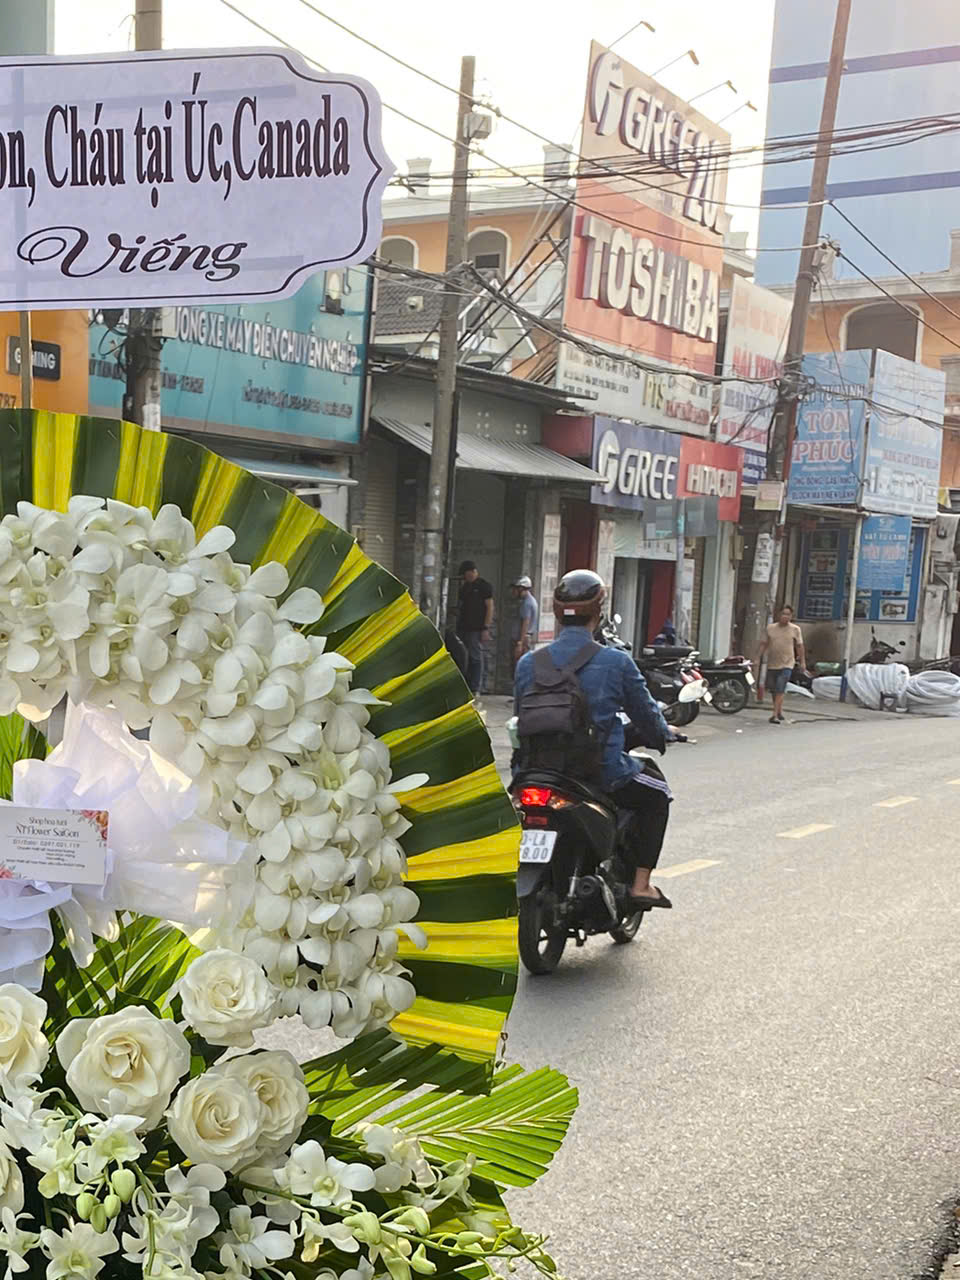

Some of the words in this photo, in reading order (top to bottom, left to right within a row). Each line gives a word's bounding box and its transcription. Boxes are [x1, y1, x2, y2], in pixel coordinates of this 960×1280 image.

[44, 103, 125, 188] Cháu
[134, 100, 174, 208] tại
[16, 225, 248, 282] Viếng
[579, 215, 719, 344] TOSHIBA
[208, 311, 225, 348] XE
[618, 447, 678, 499] GREE
